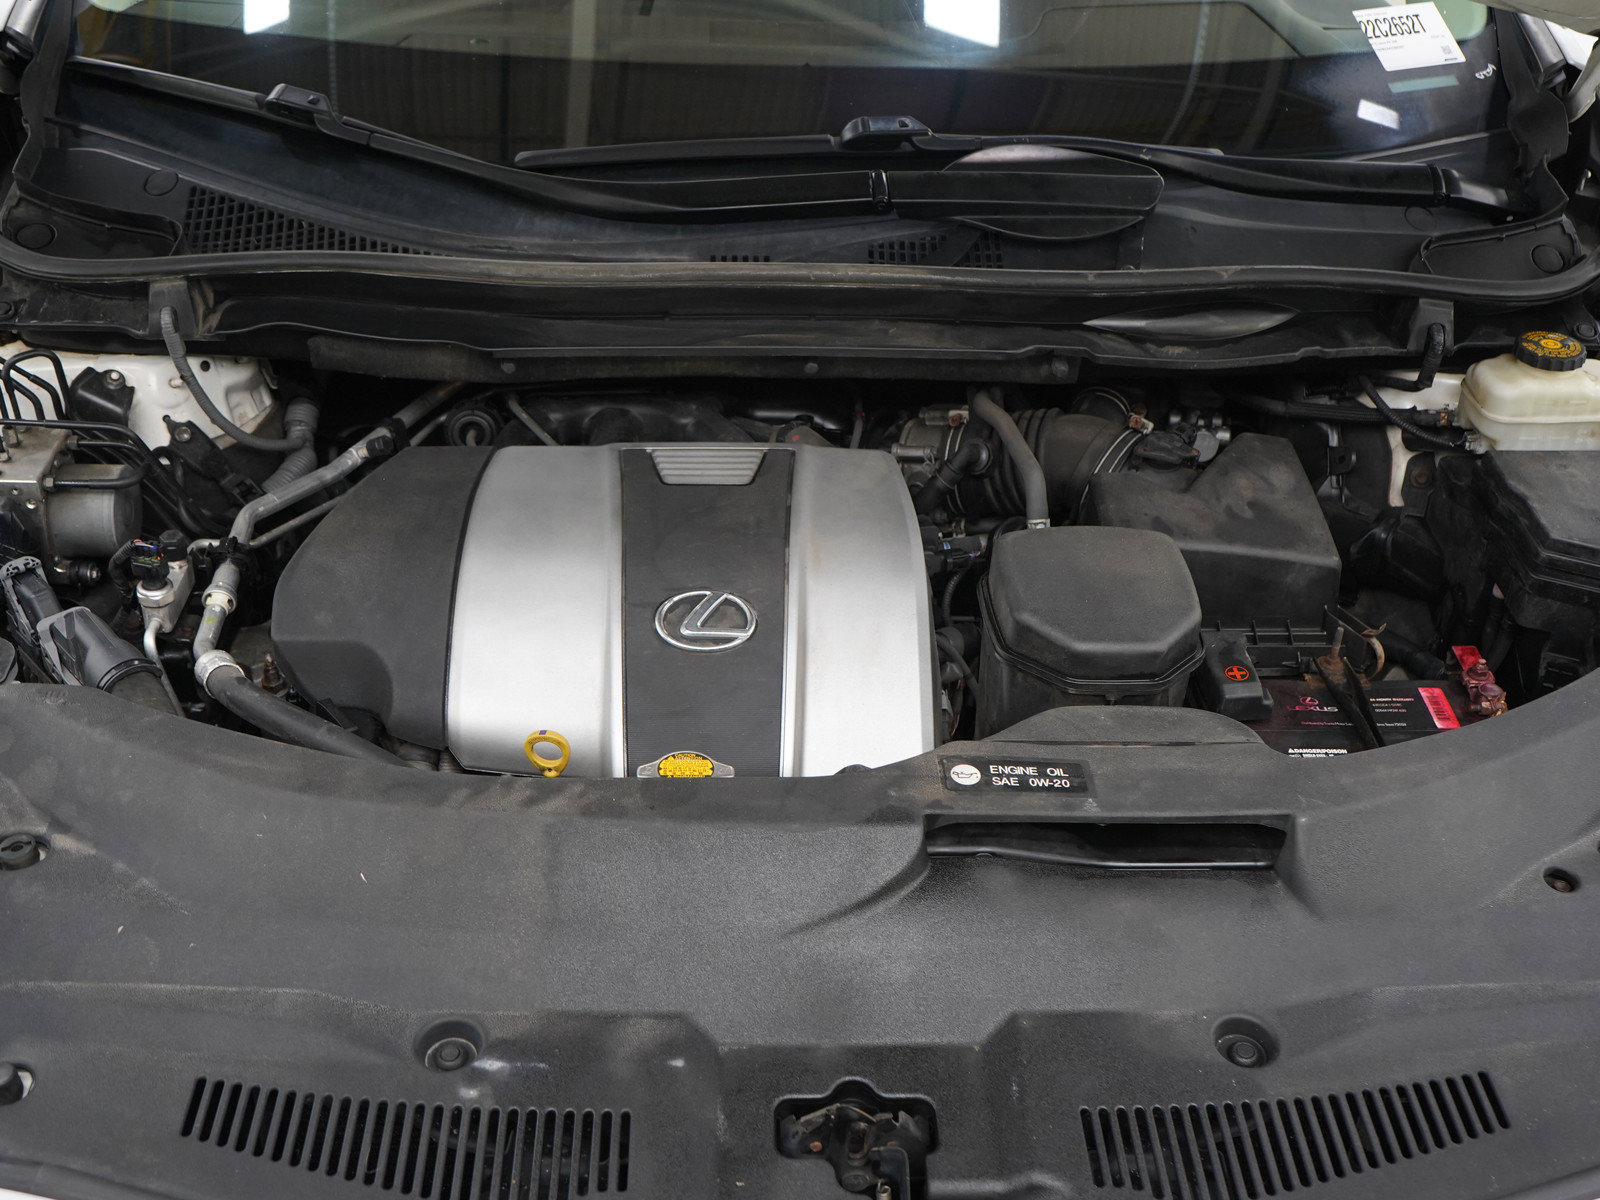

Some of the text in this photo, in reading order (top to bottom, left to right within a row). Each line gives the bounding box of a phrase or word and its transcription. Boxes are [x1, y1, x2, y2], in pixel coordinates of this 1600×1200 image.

[1358, 14, 1427, 39] 22C2652T
[989, 765, 1069, 777] ENGINE OIL
[992, 777, 1070, 788] SAE 0W-20
